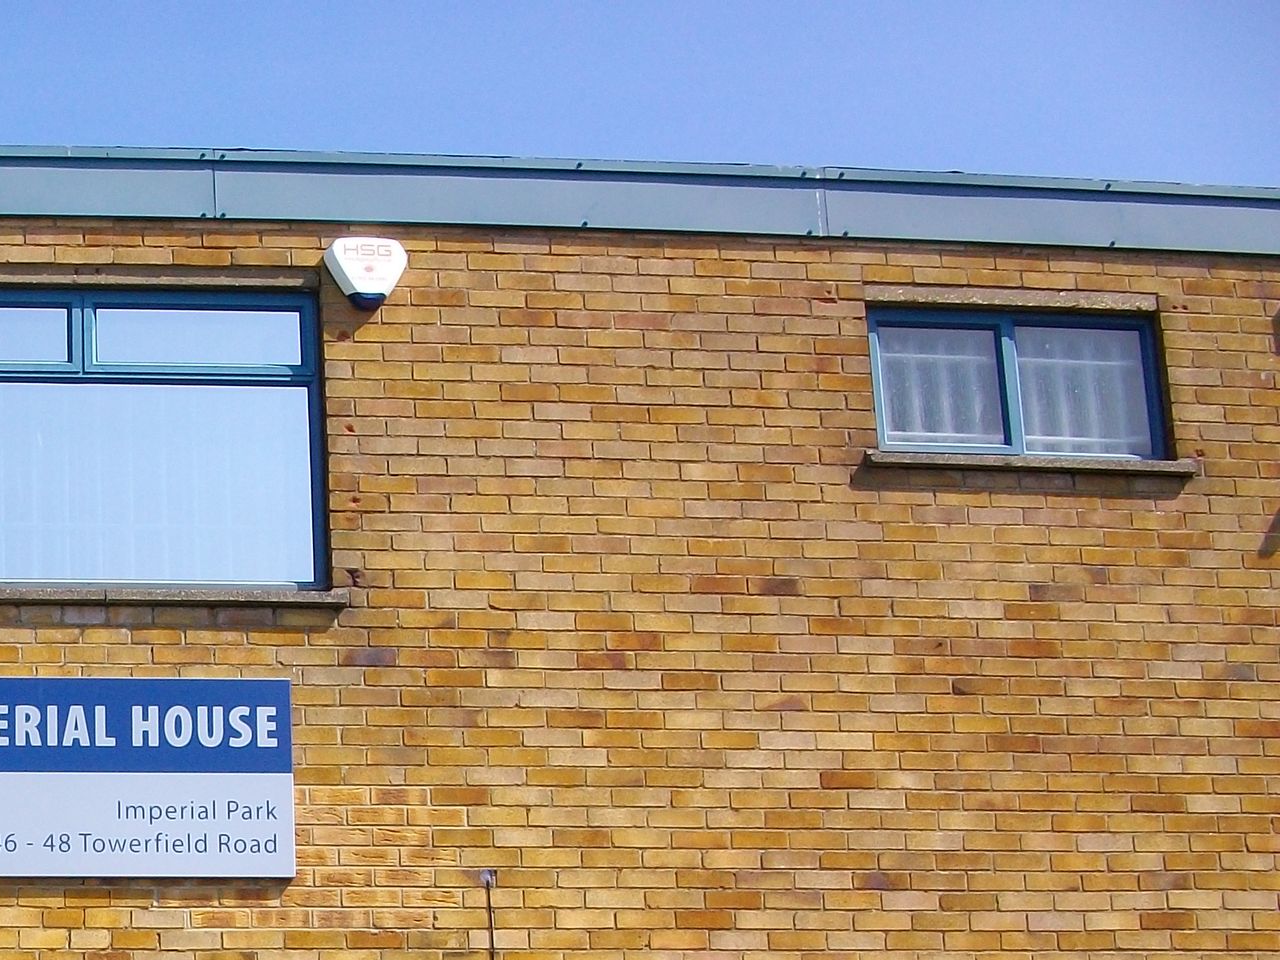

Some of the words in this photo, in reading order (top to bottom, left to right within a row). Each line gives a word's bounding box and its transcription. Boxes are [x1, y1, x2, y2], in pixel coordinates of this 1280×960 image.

[344, 244, 392, 257] HSG
[131, 705, 279, 748] HOUSE
[116, 800, 217, 824] Imperial
[226, 801, 278, 821] Park
[43, 833, 72, 853] 48
[80, 832, 208, 854] Towerfield
[218, 833, 278, 854] Road
